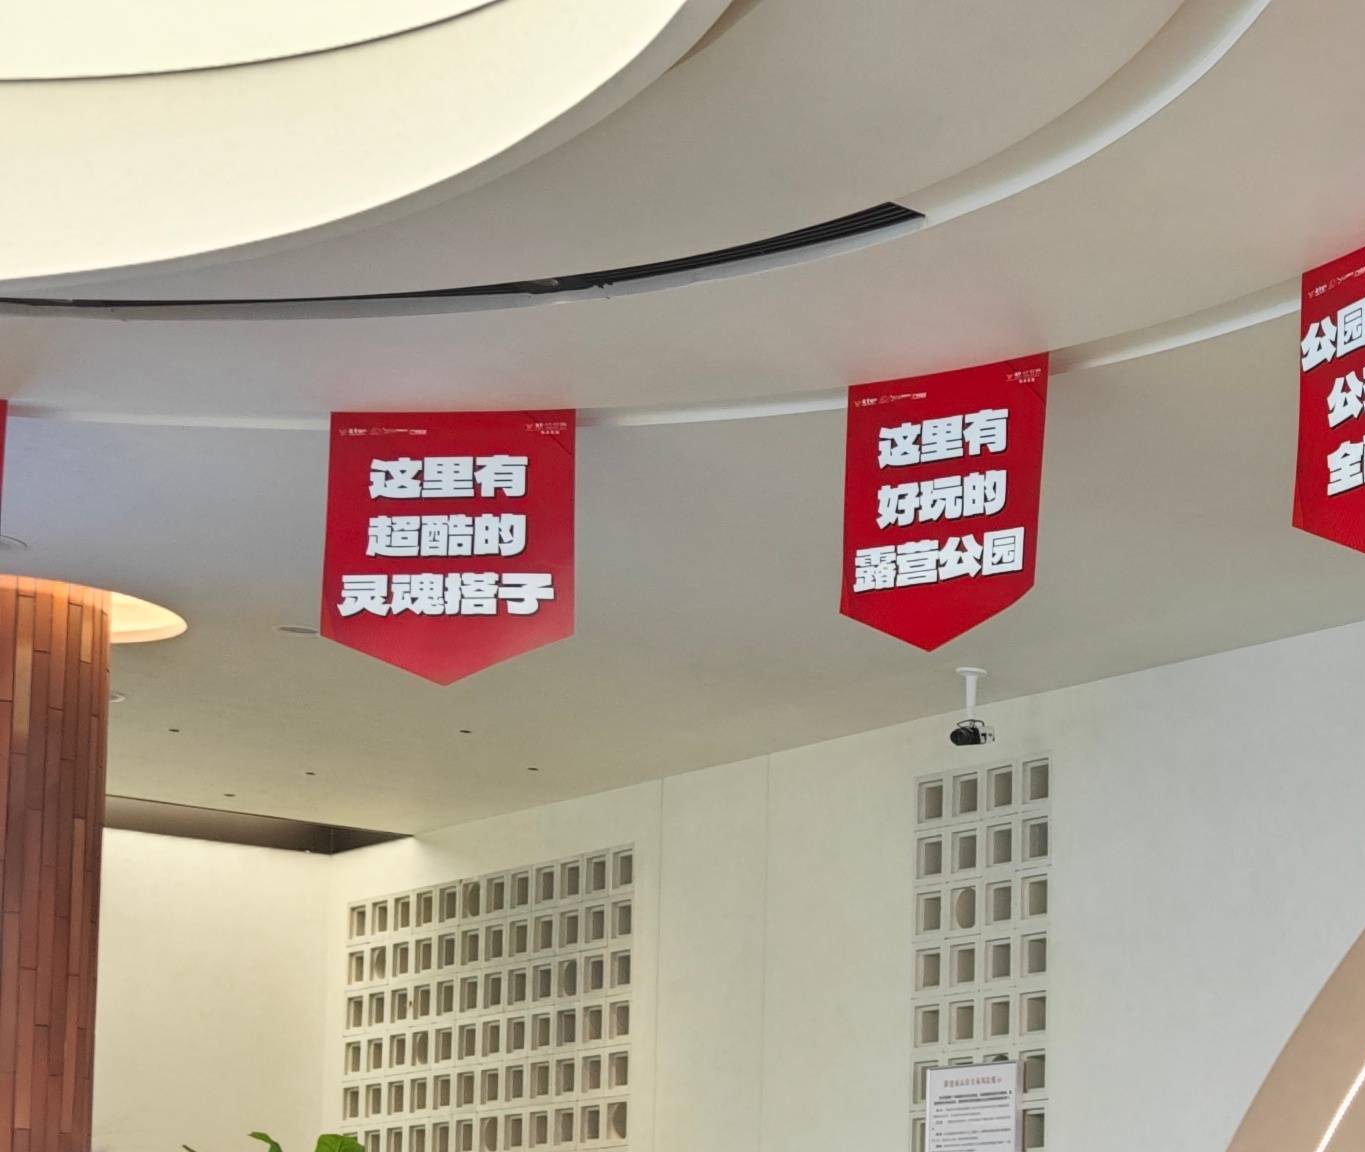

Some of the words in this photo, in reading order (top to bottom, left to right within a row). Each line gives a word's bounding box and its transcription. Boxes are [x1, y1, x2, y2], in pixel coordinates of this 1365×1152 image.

[878, 408, 1009, 470] 这里有
[369, 454, 528, 500] 这里有
[876, 469, 1007, 530] 好玩的
[366, 513, 527, 558] 超酷的
[853, 526, 1025, 593] 露营公园
[337, 572, 555, 617] 灵魂搭子
